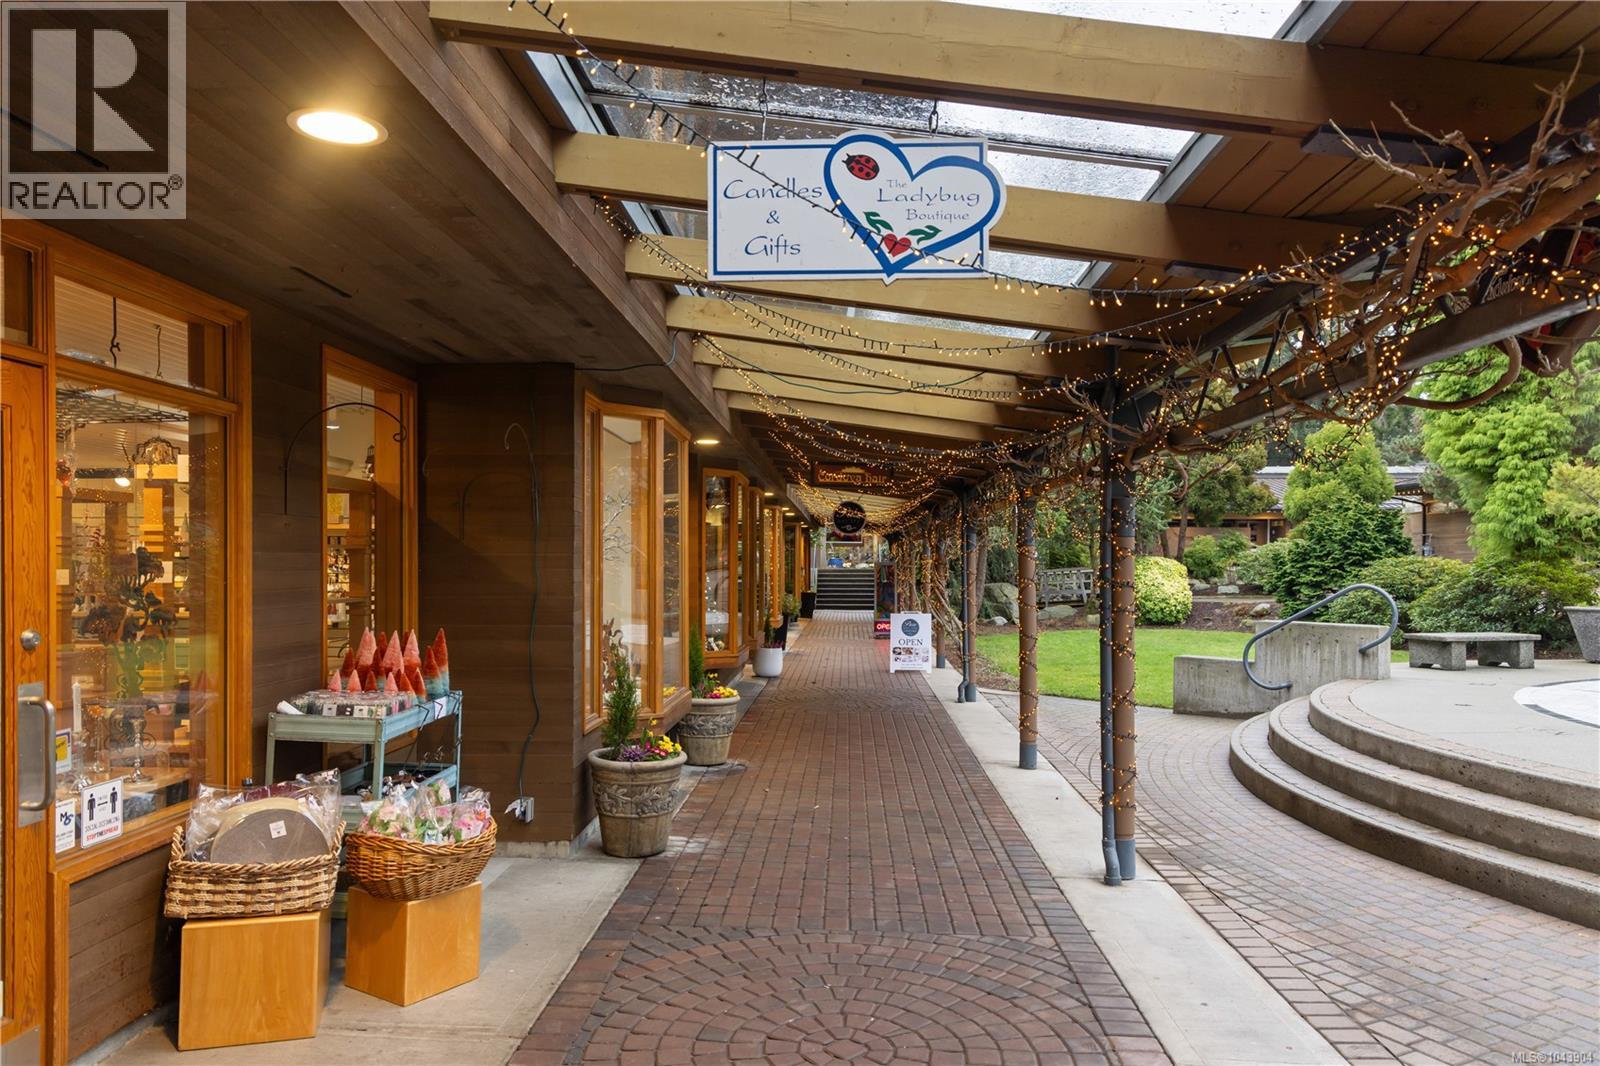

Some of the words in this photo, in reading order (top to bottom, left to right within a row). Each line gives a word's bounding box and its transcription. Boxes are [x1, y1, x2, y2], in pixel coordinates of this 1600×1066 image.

[723, 178, 823, 200] Candles
[887, 180, 907, 188] The
[877, 186, 980, 207] Ladybug
[766, 210, 781, 225] &
[906, 208, 969, 224] Boutique
[744, 236, 801, 263] Gifts
